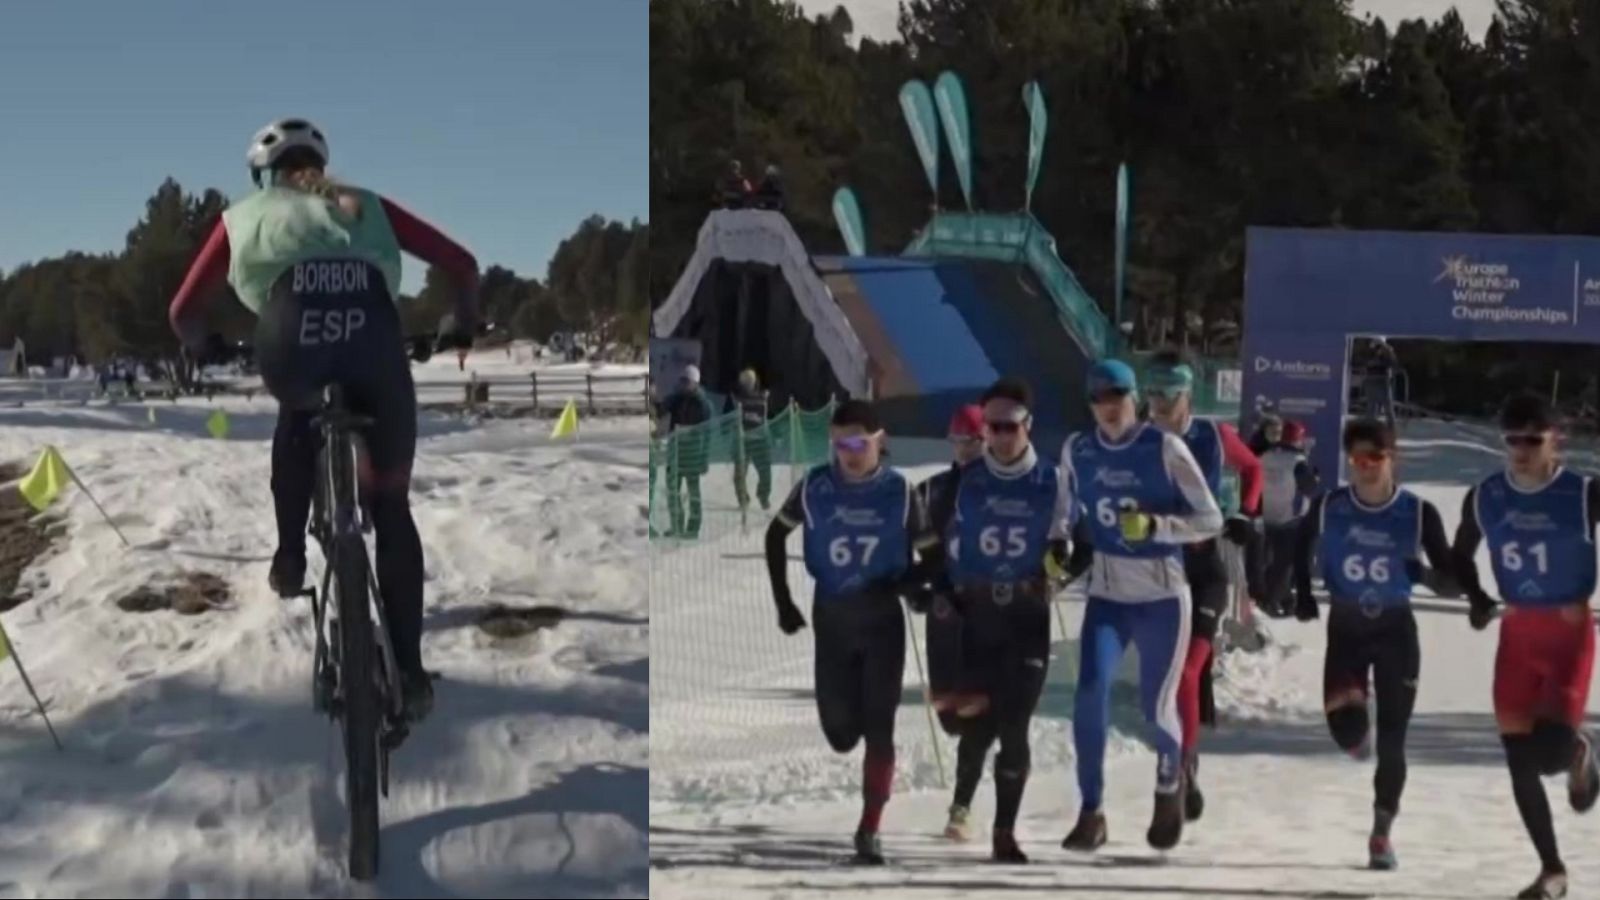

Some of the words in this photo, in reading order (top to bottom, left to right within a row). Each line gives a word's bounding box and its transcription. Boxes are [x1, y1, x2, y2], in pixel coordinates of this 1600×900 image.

[292, 262, 368, 293] BORBON
[1454, 262, 1508, 277] Europe
[1452, 289, 1505, 303] Winter
[299, 308, 366, 345] ESP
[1452, 305, 1569, 325] Championships
[829, 535, 880, 567] 67
[979, 525, 1027, 557] 65
[1342, 554, 1391, 583] 66
[1501, 541, 1548, 574] 61
